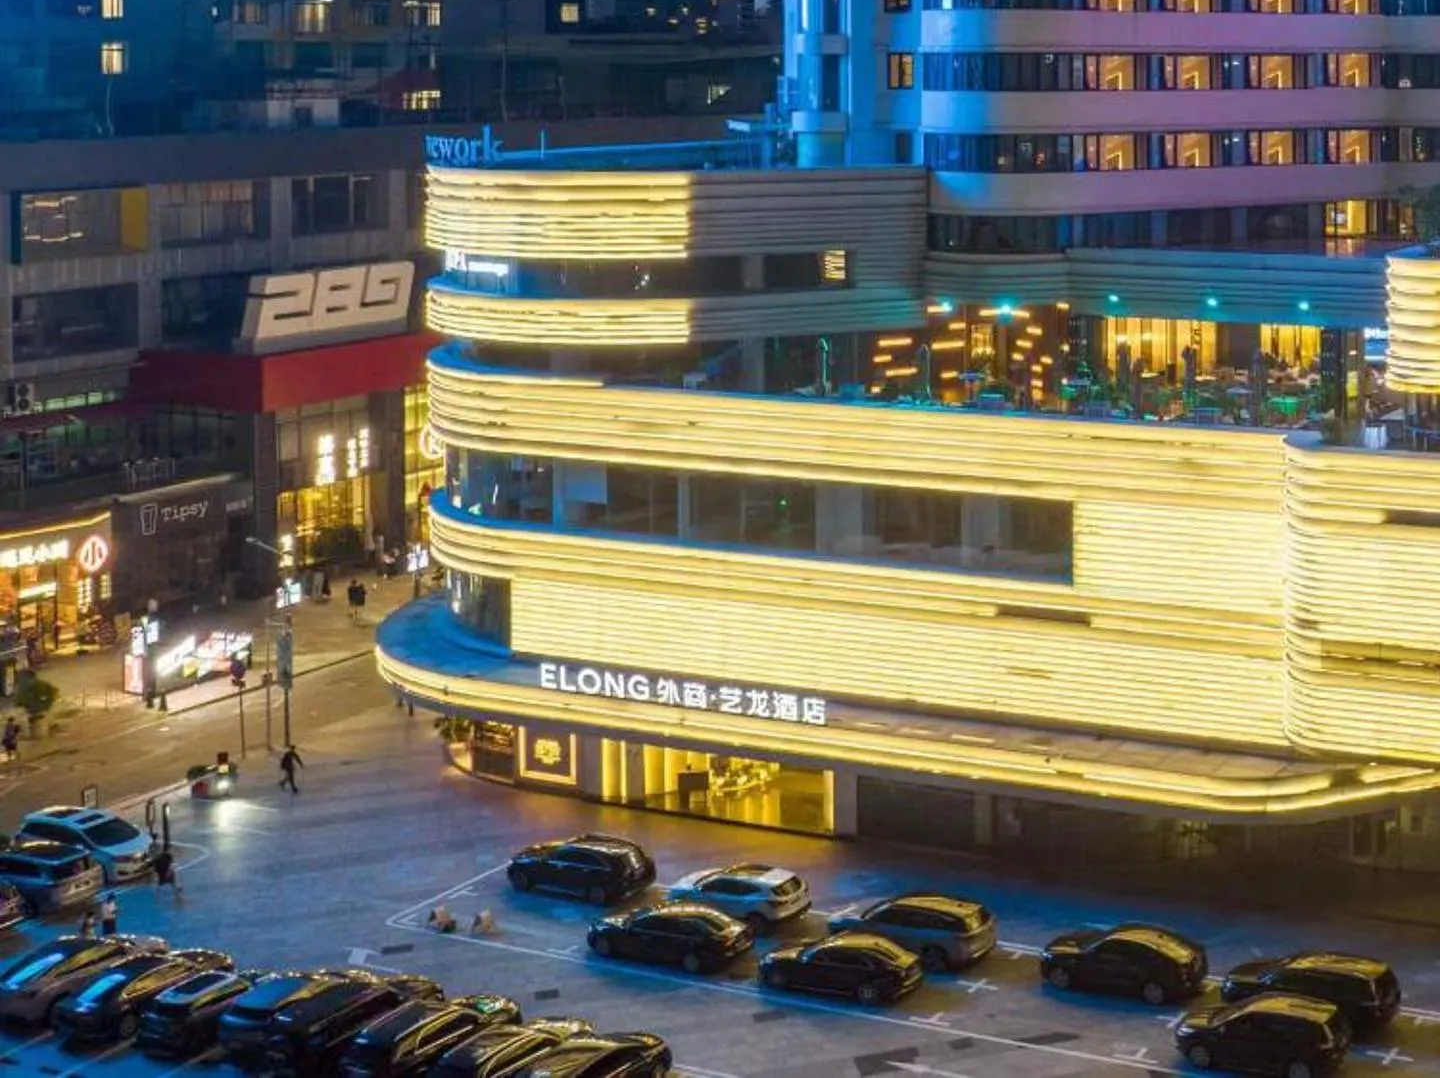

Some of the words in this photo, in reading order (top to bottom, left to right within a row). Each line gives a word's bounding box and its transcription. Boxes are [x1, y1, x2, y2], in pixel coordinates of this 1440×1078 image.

[256, 261, 415, 339] 289
[161, 501, 209, 521] Tipsy
[540, 663, 650, 701] ELONG
[656, 677, 826, 726] 外商·艺龙酒店
